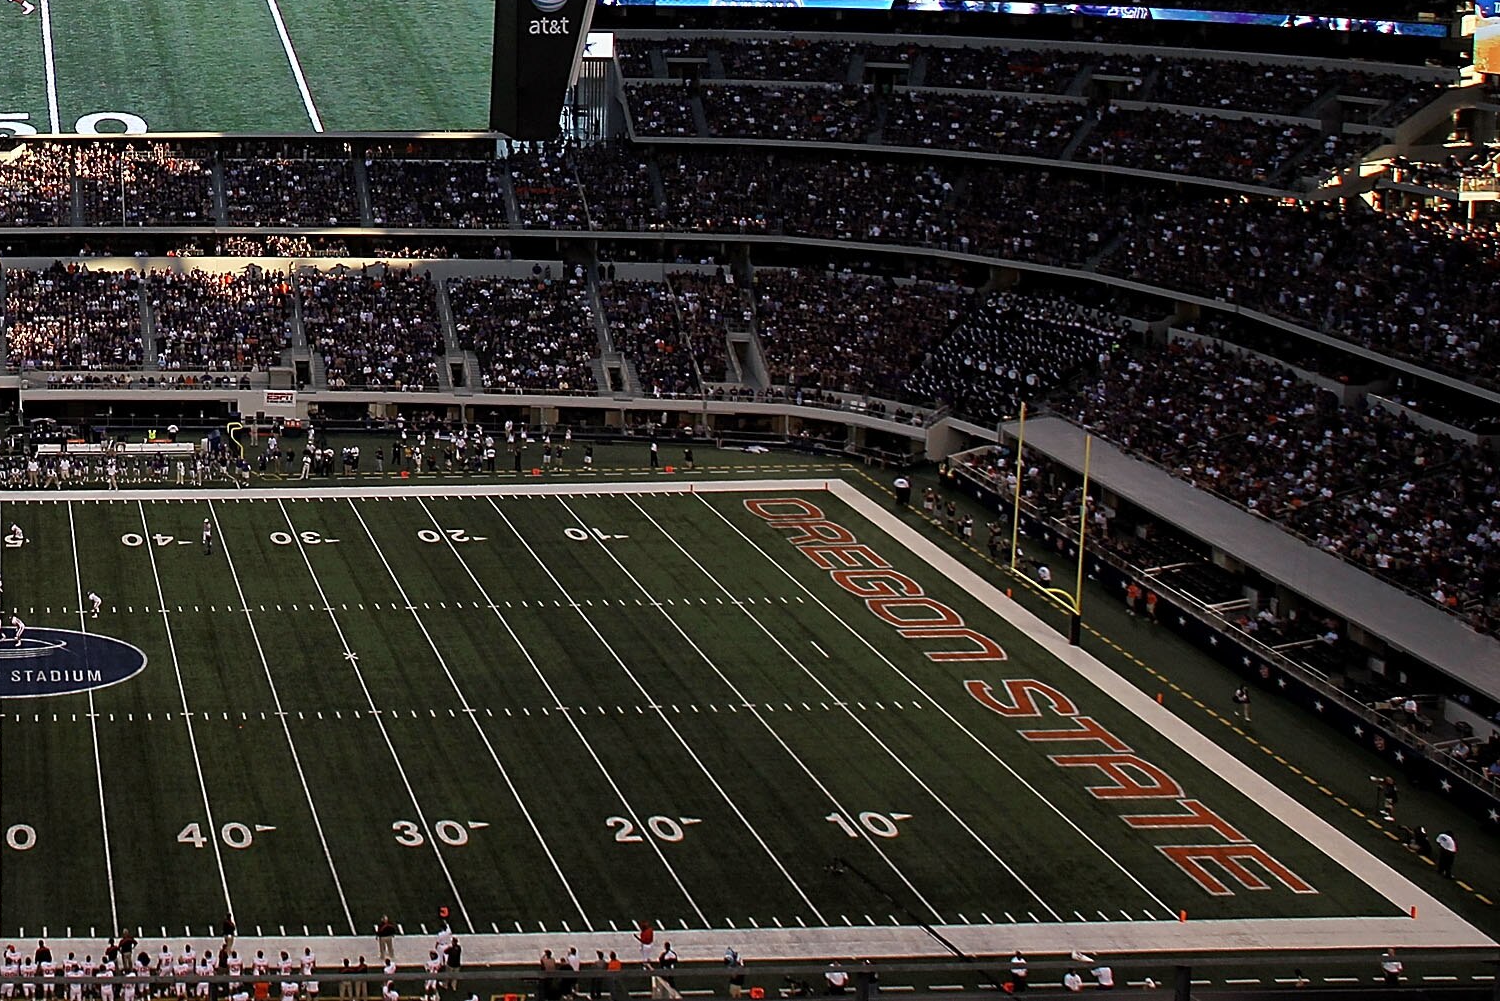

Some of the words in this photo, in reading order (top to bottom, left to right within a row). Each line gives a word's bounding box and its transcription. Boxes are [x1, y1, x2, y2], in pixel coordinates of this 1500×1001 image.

[528, 16, 570, 35] at&t
[741, 497, 1008, 662] OREGON
[11, 669, 103, 683] STADIUM
[963, 678, 1320, 896] STATE
